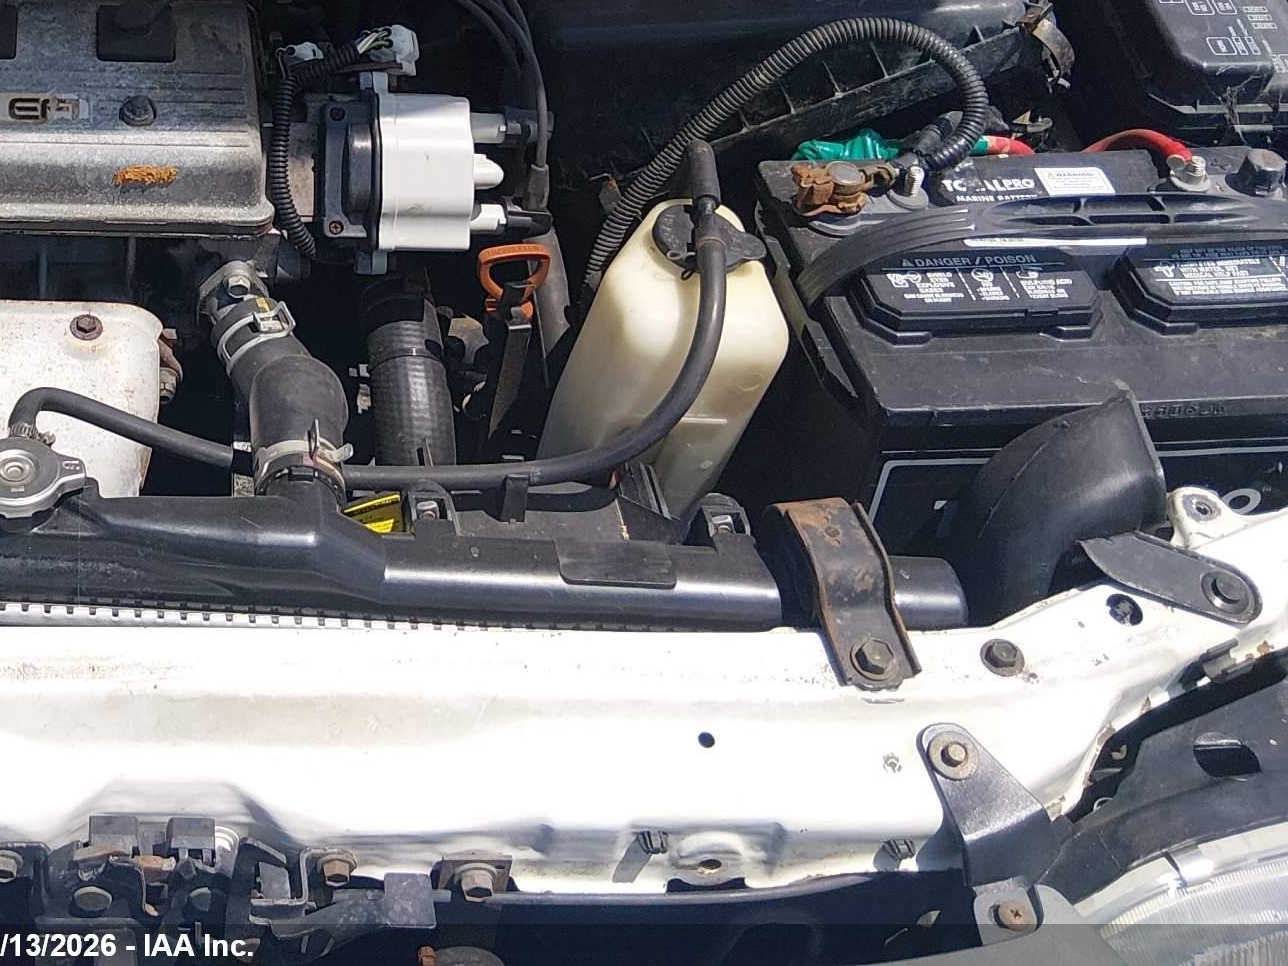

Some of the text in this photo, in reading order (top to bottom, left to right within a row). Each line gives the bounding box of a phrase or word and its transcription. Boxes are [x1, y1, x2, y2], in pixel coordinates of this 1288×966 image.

[956, 194, 996, 203] MARINE
[914, 256, 972, 267] DANGER
[985, 254, 1037, 265] POISON
